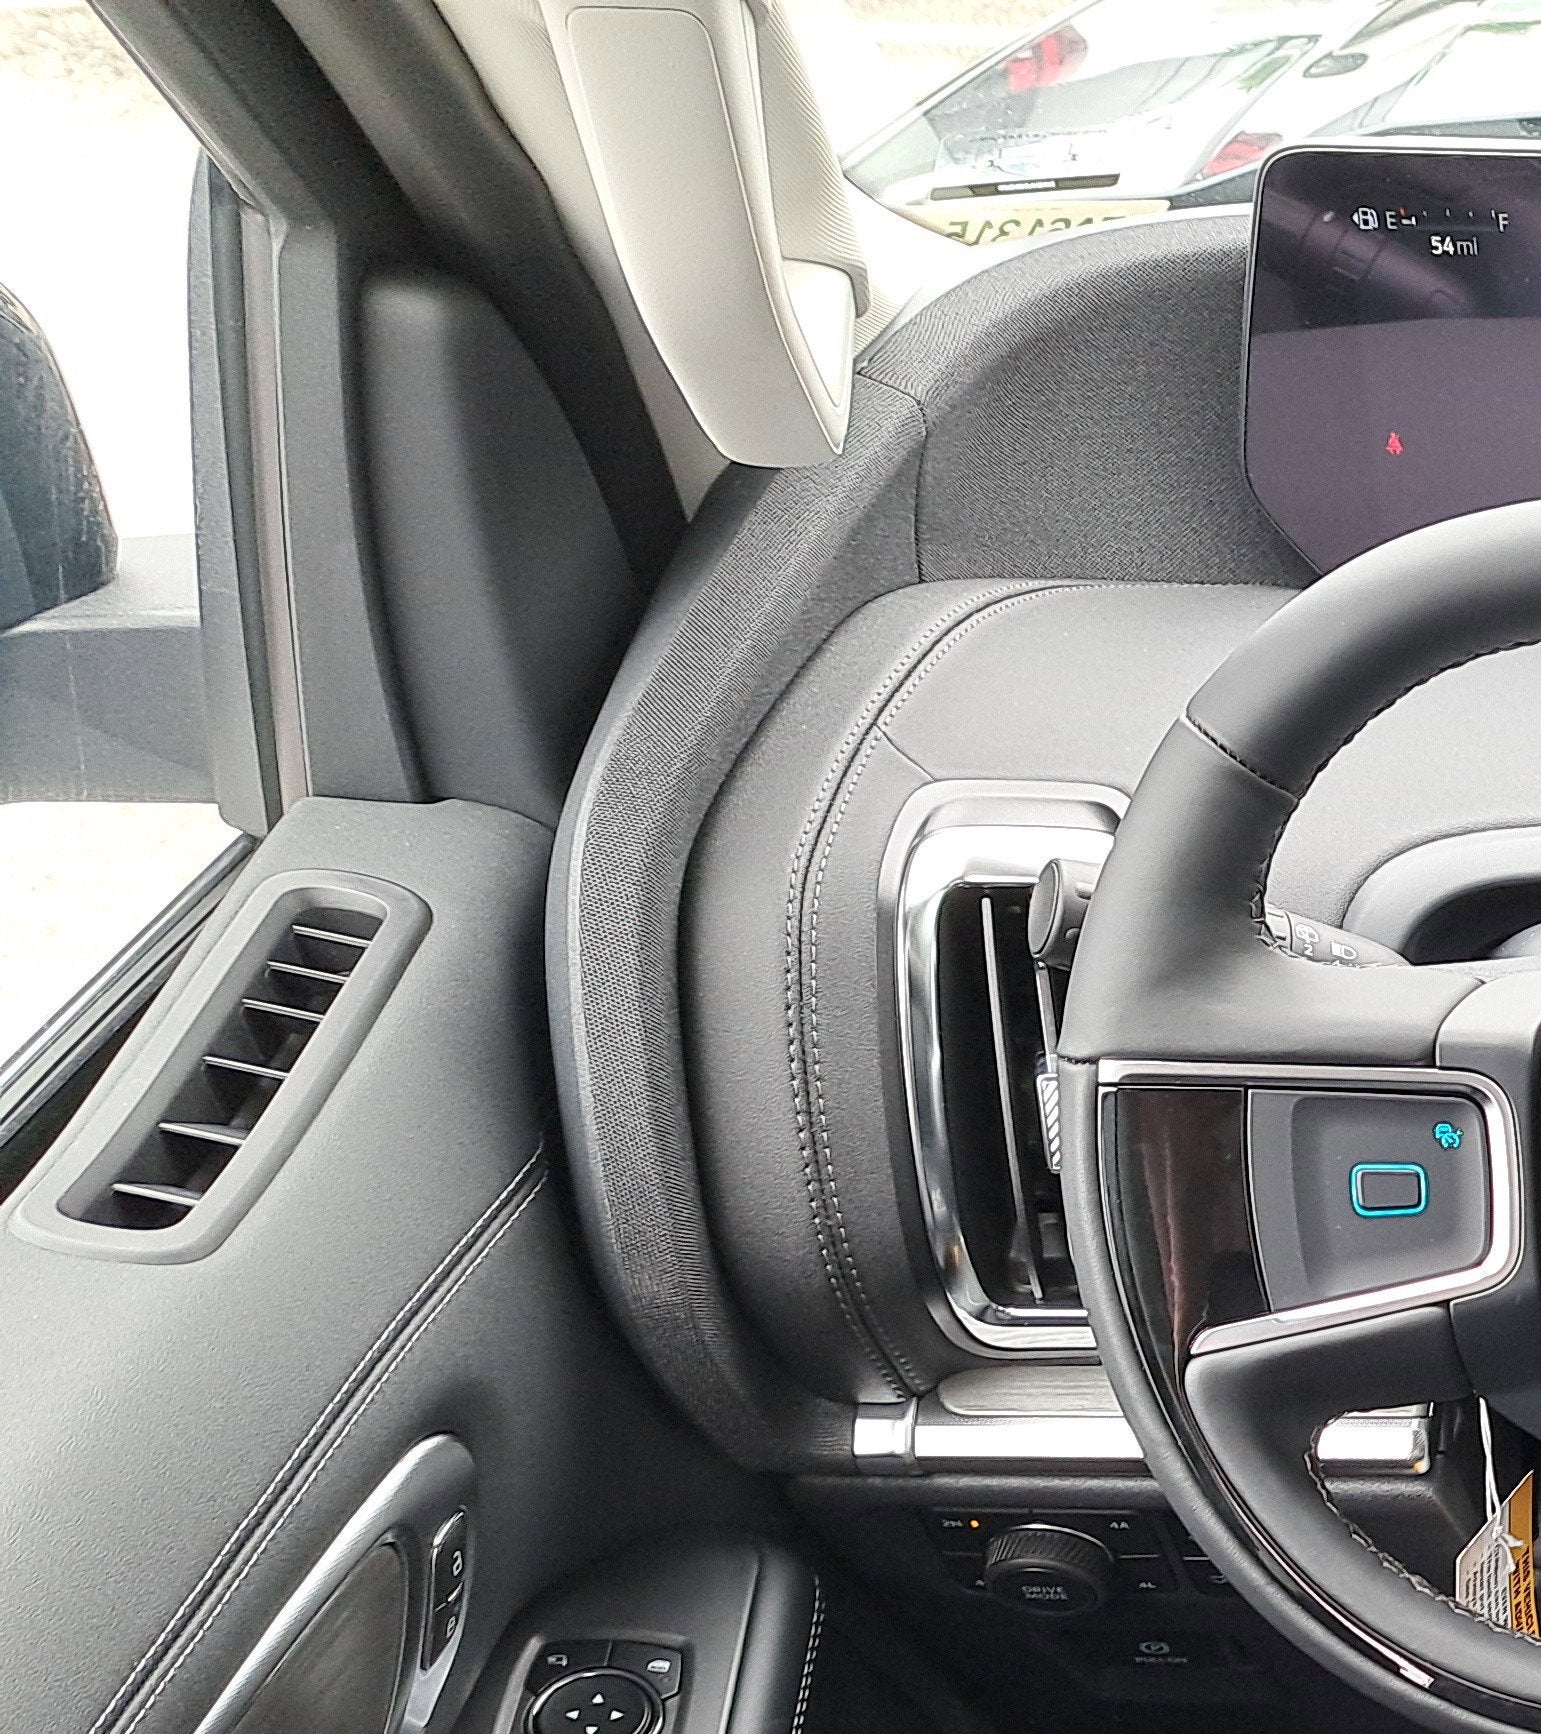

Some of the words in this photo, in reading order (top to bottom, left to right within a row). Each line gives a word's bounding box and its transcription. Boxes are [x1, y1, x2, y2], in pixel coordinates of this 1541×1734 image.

[1385, 211, 1398, 229] E
[1498, 213, 1510, 232] F
[1430, 235, 1454, 256] 54
